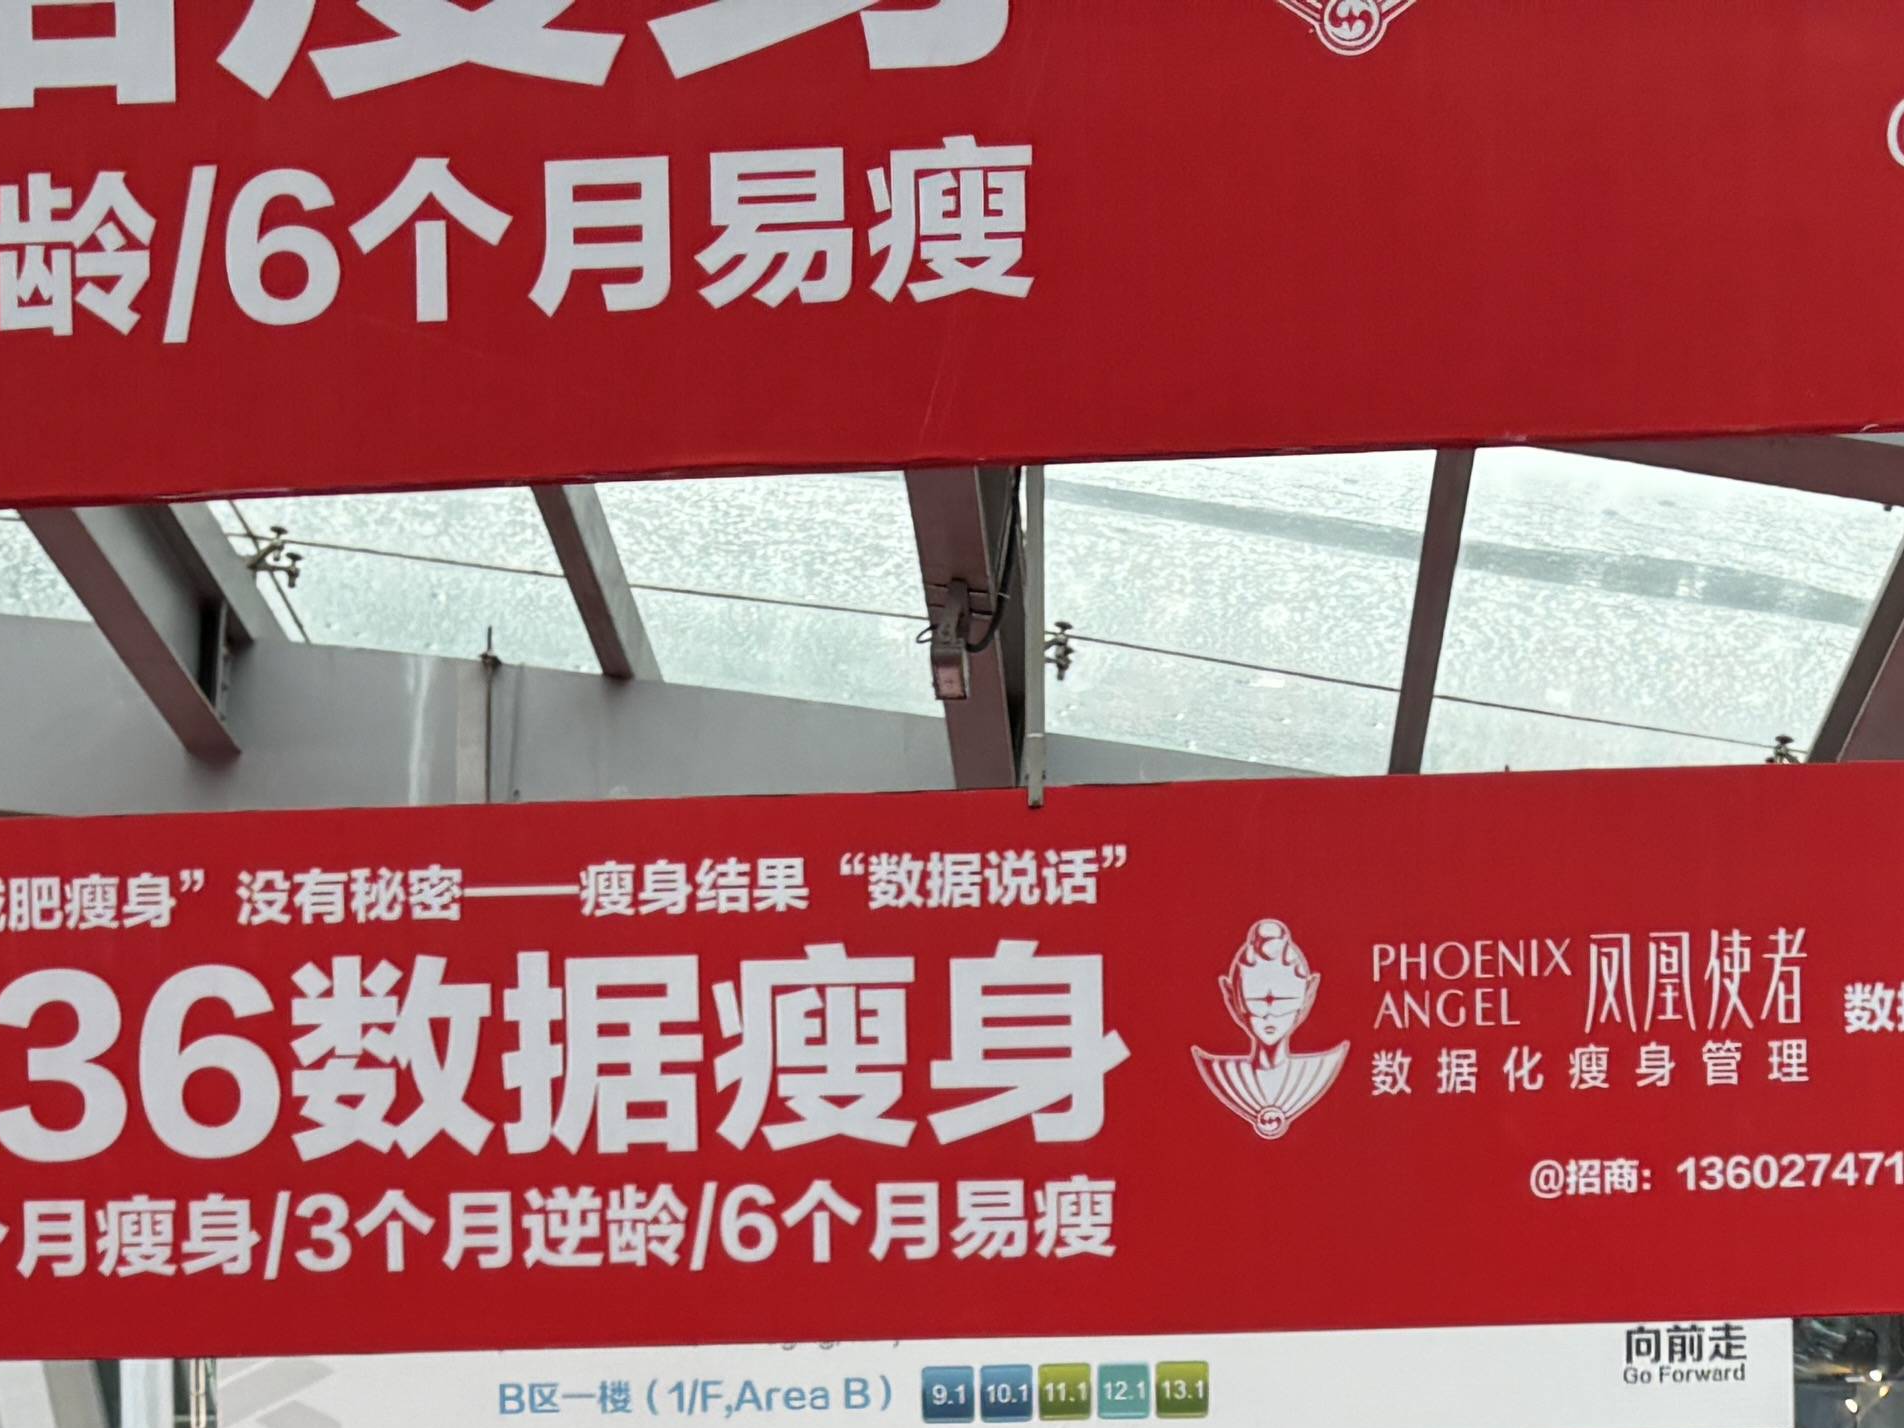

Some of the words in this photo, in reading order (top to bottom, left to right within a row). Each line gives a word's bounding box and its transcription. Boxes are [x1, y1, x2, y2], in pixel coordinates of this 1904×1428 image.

[1373, 937, 1572, 982] PHOENIX
[1584, 926, 1808, 1034] 凤凰使者
[1374, 987, 1521, 1030] ANGEL
[1371, 1038, 1810, 1096] 数据化瘦身管理
[1623, 1326, 1747, 1364] 向前走
[932, 1384, 966, 1406] 9.1
[986, 1383, 1029, 1405] 10.1
[1043, 1382, 1087, 1403] 11.1
[1103, 1380, 1146, 1402] 12.1
[1162, 1378, 1205, 1400] 13.1
[1623, 1365, 1663, 1385] Go
[1669, 1360, 1748, 1384] Forward
